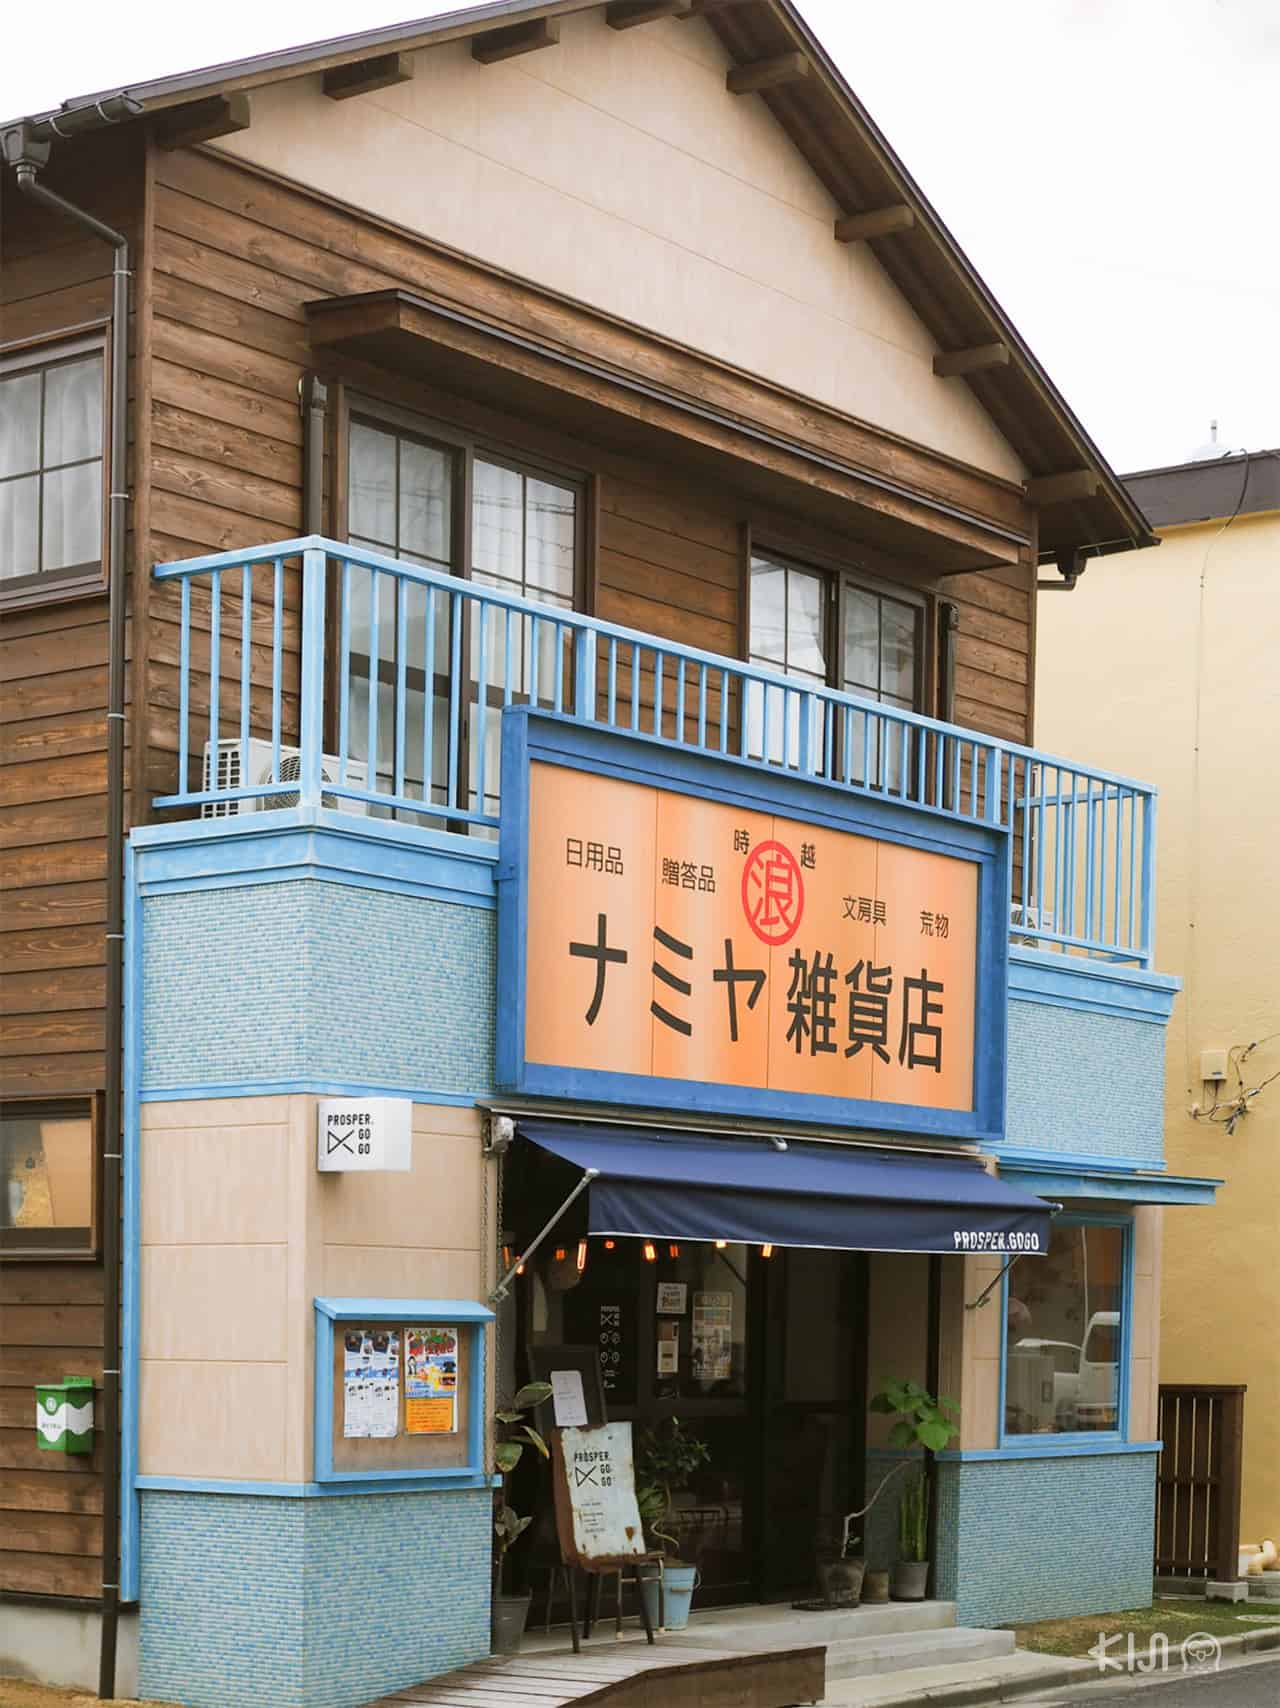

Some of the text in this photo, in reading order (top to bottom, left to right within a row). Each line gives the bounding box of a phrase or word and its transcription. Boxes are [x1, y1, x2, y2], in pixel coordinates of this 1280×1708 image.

[566, 837, 624, 876] 日用品
[733, 828, 750, 855] 時
[800, 842, 816, 870] 越
[661, 857, 716, 893] 贈答品
[749, 853, 794, 929] 浪
[842, 894, 888, 927] 文房具
[919, 910, 950, 939] 荒物
[568, 912, 945, 1074] ナミヤ雑貨店
[358, 1128, 371, 1140] GO
[358, 1143, 371, 1155] GO
